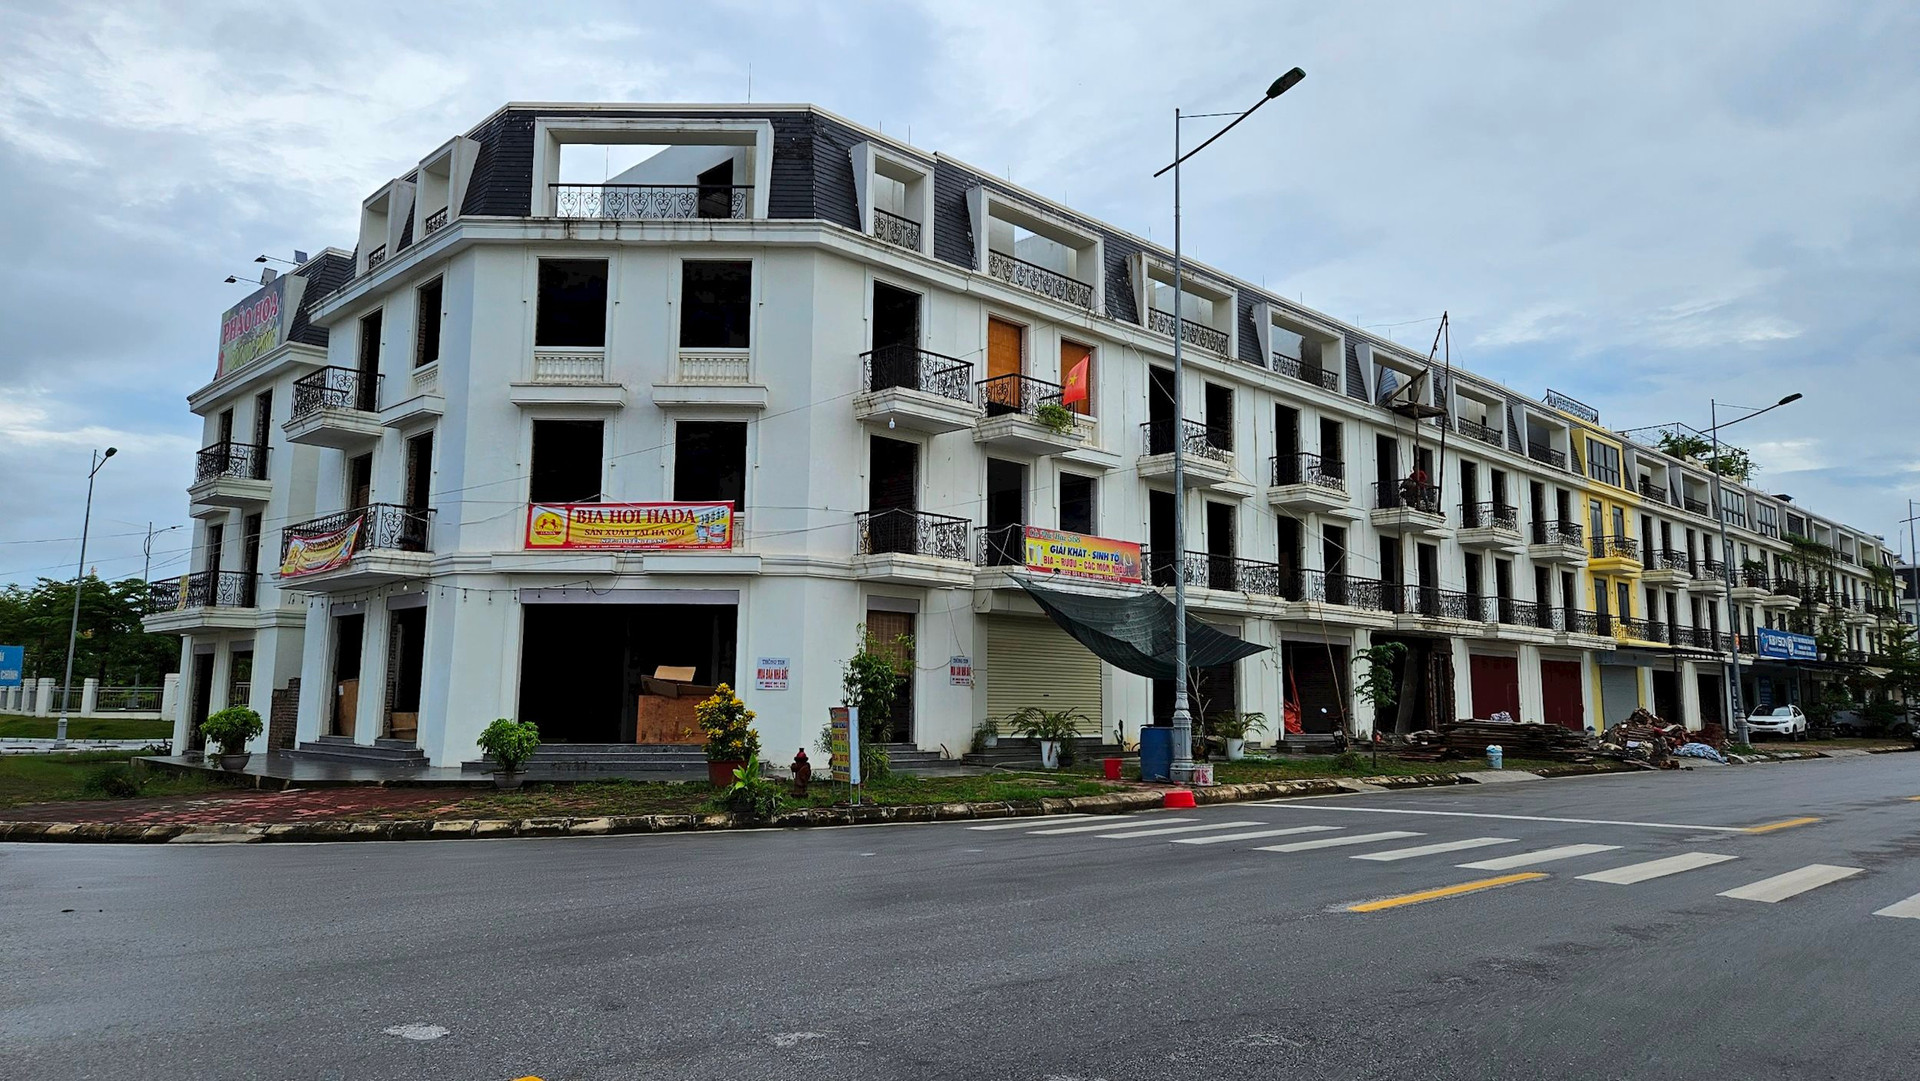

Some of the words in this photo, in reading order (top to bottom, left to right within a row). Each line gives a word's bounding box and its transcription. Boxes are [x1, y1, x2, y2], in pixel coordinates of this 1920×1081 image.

[253, 291, 279, 329] HOA
[576, 509, 604, 523] BIA
[647, 508, 696, 524] HADA
[668, 528, 685, 537] NỘI
[1043, 556, 1054, 565] BIA
[1050, 543, 1066, 555] GIẢI
[1067, 547, 1087, 558] KHÁT
[1092, 551, 1109, 561] SINH
[1110, 550, 1120, 562] TỐ
